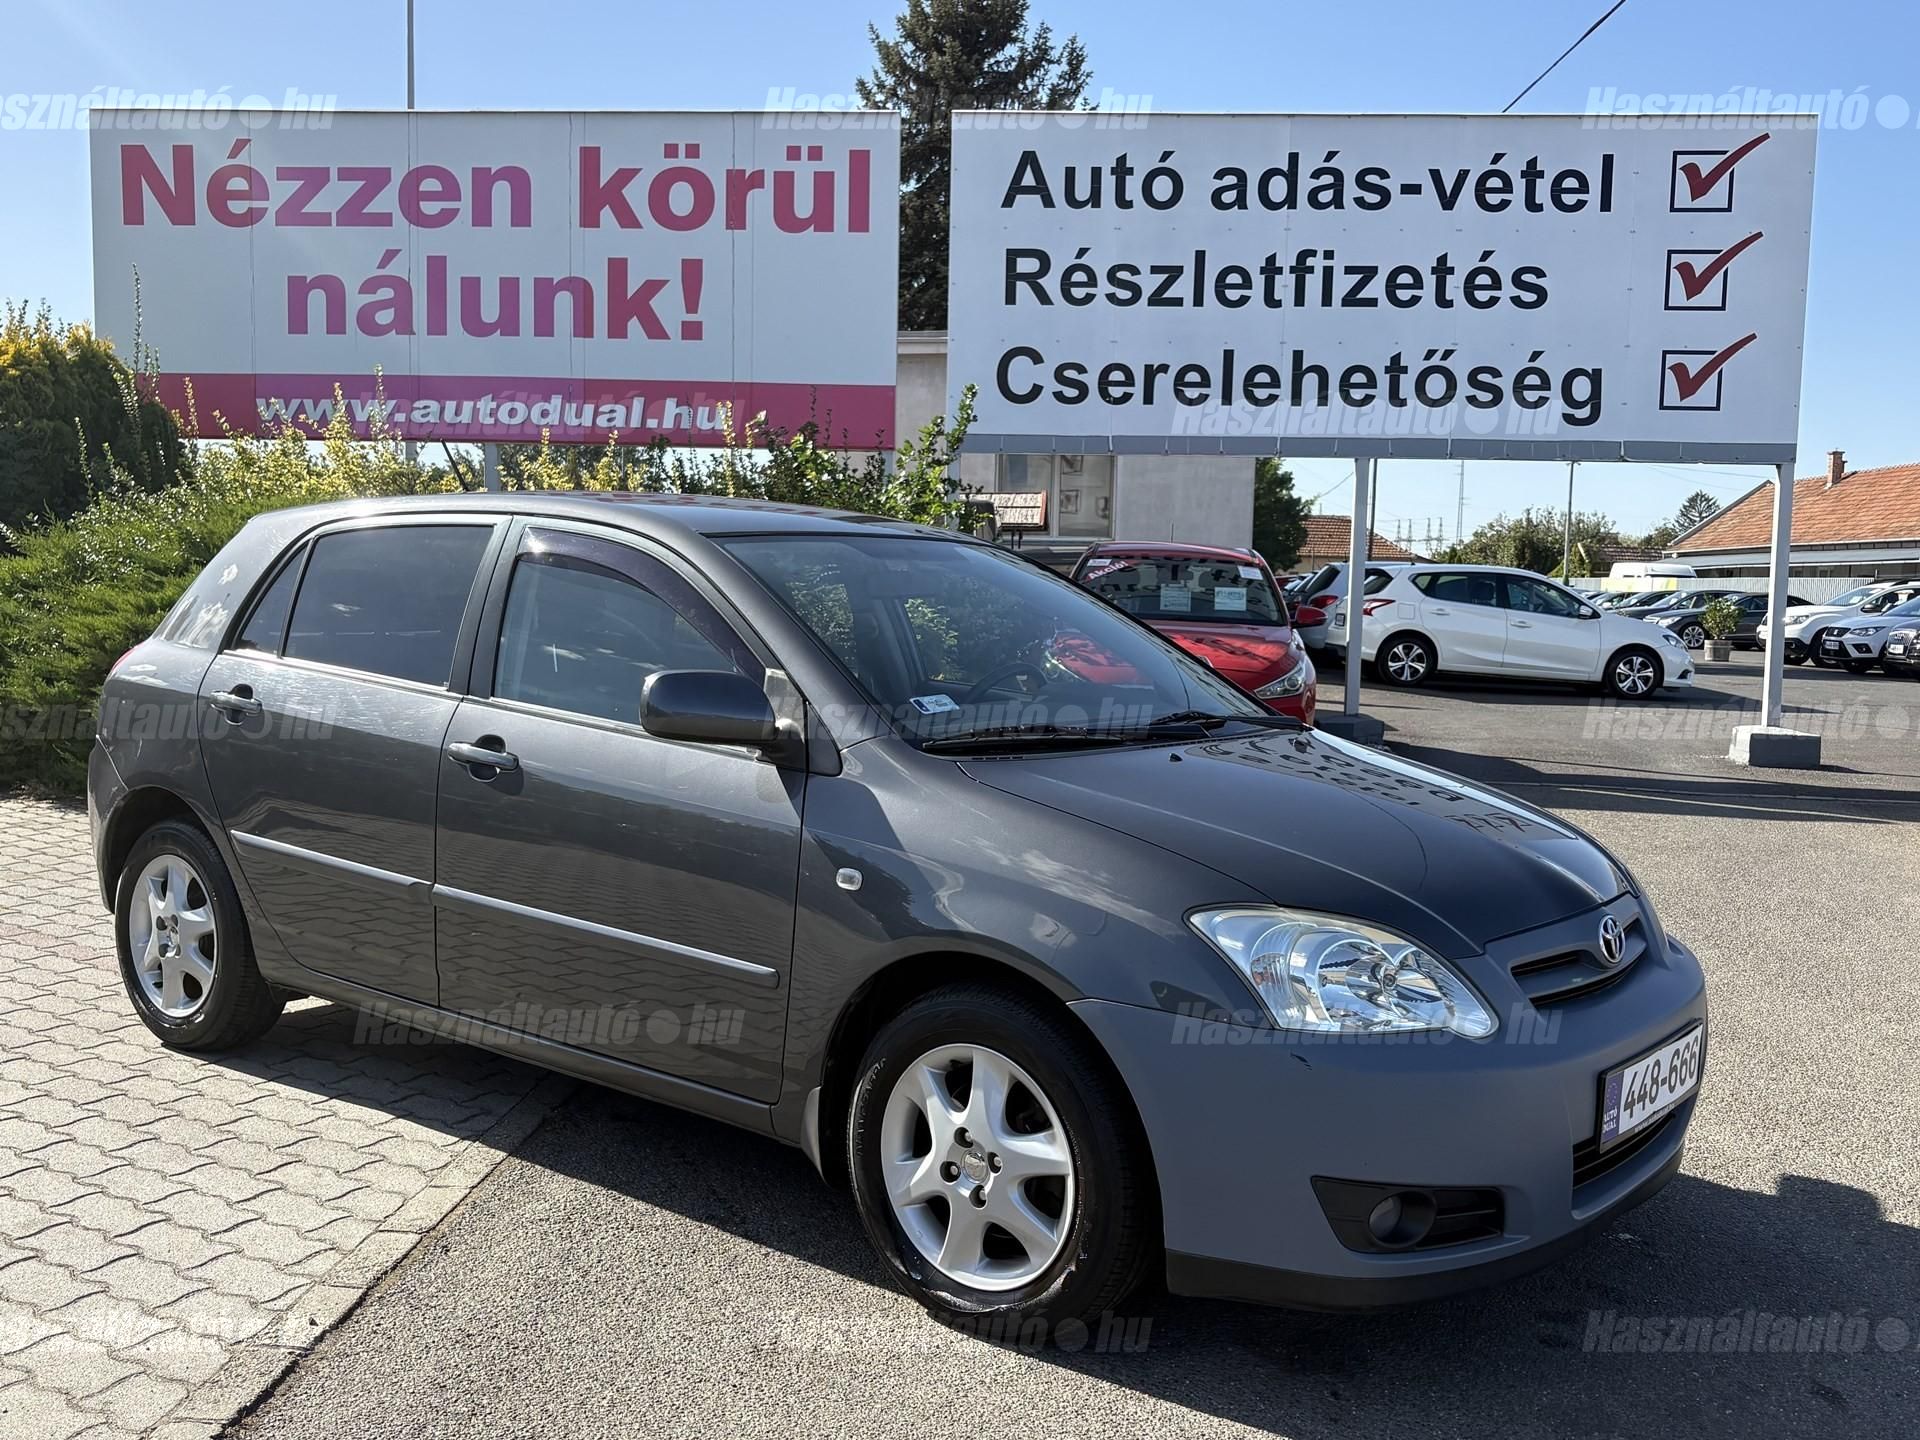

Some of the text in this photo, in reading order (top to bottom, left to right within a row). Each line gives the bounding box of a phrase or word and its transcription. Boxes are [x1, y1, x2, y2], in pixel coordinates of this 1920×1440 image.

[120, 138, 871, 234] Nézzen körül
[1000, 150, 1615, 213] Autó adás-vétel
[287, 248, 704, 341] nálunk!
[1003, 247, 1549, 310] Részletfizetés
[255, 393, 726, 431] www.autodual.hu
[996, 345, 1604, 427] Cserelehetőség
[1623, 1035, 1699, 1120] 448-666
